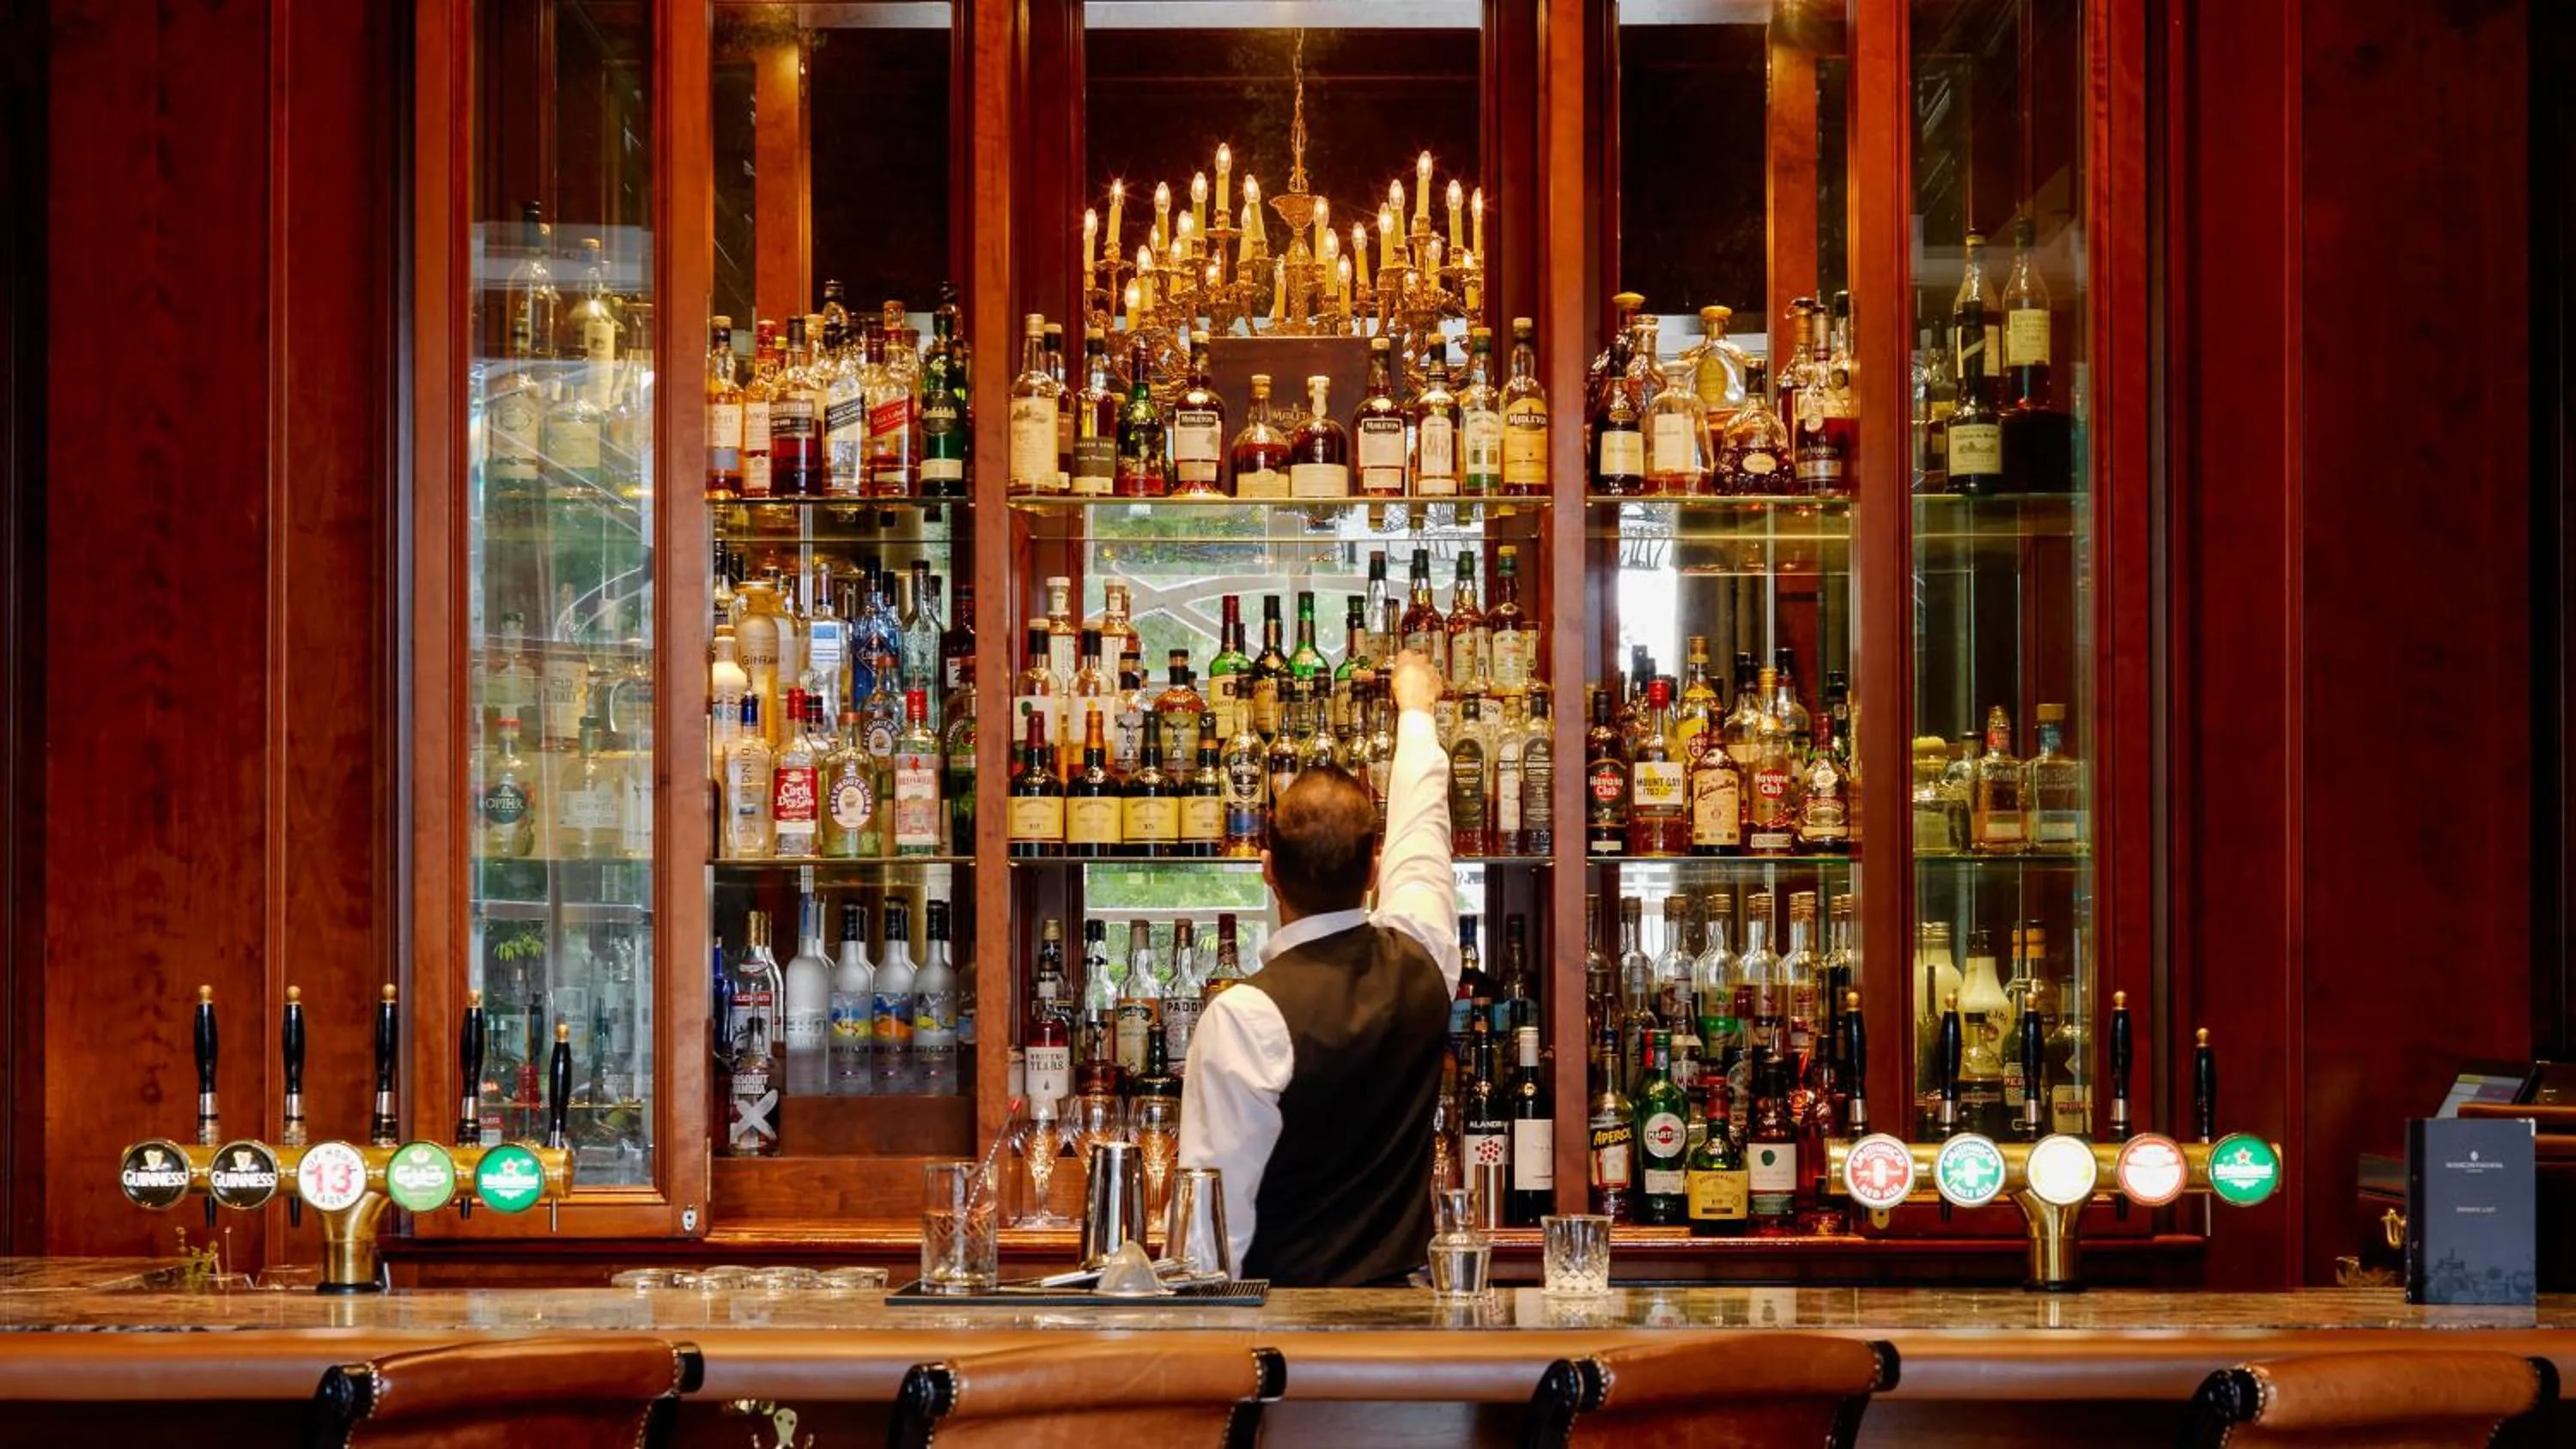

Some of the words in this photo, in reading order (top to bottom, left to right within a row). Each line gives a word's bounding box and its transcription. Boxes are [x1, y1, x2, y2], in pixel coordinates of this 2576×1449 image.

[1596, 785, 1618, 796] Club
[1636, 777, 1664, 787] MOUNT
[1593, 1127, 1631, 1146] APEROL
[123, 1169, 188, 1187] GUINNESS
[211, 1170, 276, 1187] GUINNESS
[315, 1163, 352, 1194] 13
